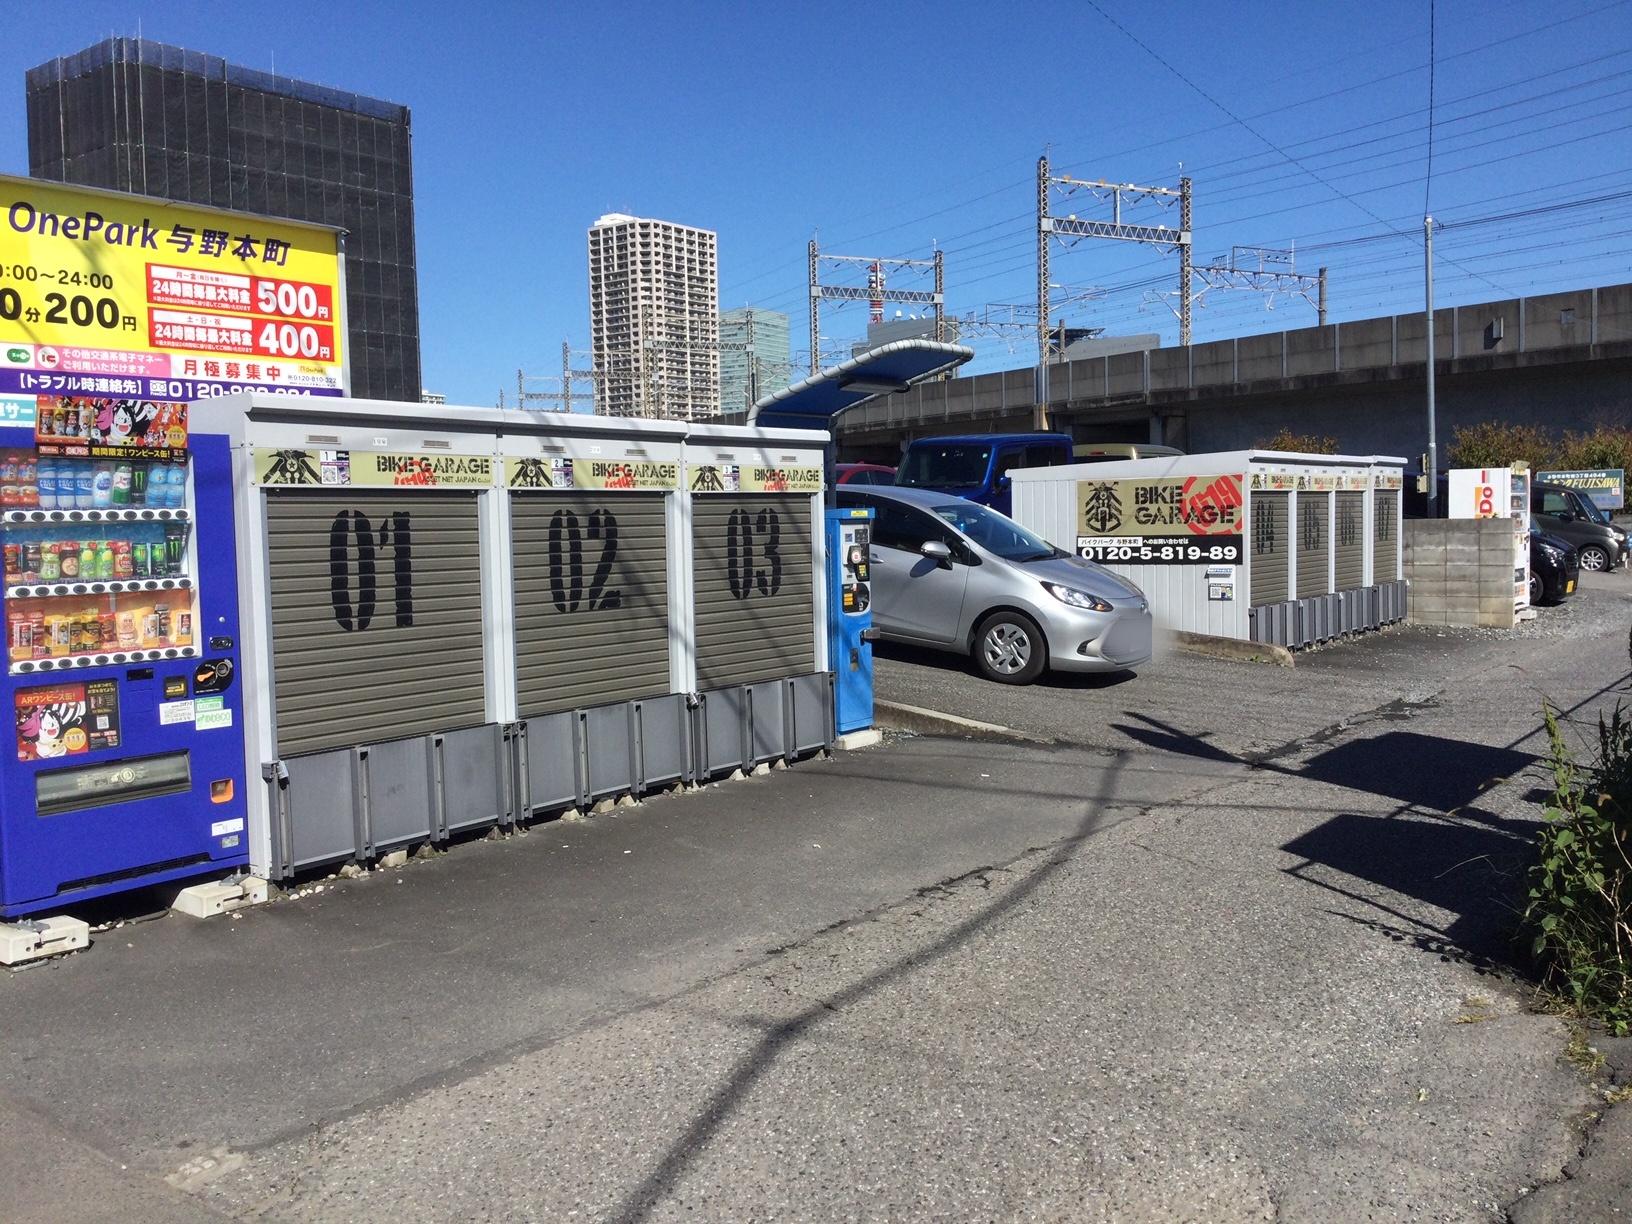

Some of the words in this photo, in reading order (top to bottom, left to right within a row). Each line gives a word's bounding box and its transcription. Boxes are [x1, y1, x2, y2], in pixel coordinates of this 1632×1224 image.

[9, 201, 158, 250] OnePark
[166, 224, 291, 266] 与野本町
[0, 263, 113, 289] :00～24:00
[257, 281, 328, 318] 500円
[259, 323, 330, 358] 400円
[183, 359, 281, 381] 月極募集中
[19, 373, 144, 395] 【トラブル時連絡先】
[376, 455, 414, 473] BIKE
[418, 456, 490, 475] GARAGE
[592, 462, 620, 477] BIKE
[623, 463, 676, 478] GARAGE
[754, 468, 776, 482] BIKE
[778, 469, 819, 482] GARAGE
[1571, 477, 1620, 489] FUJISAWA
[1135, 485, 1184, 505] BIKE
[1135, 504, 1235, 525] GARAGE
[549, 508, 622, 614] 02
[727, 507, 782, 600] 03
[1081, 545, 1237, 561] 0120-5-819-89
[330, 509, 413, 632] 01
